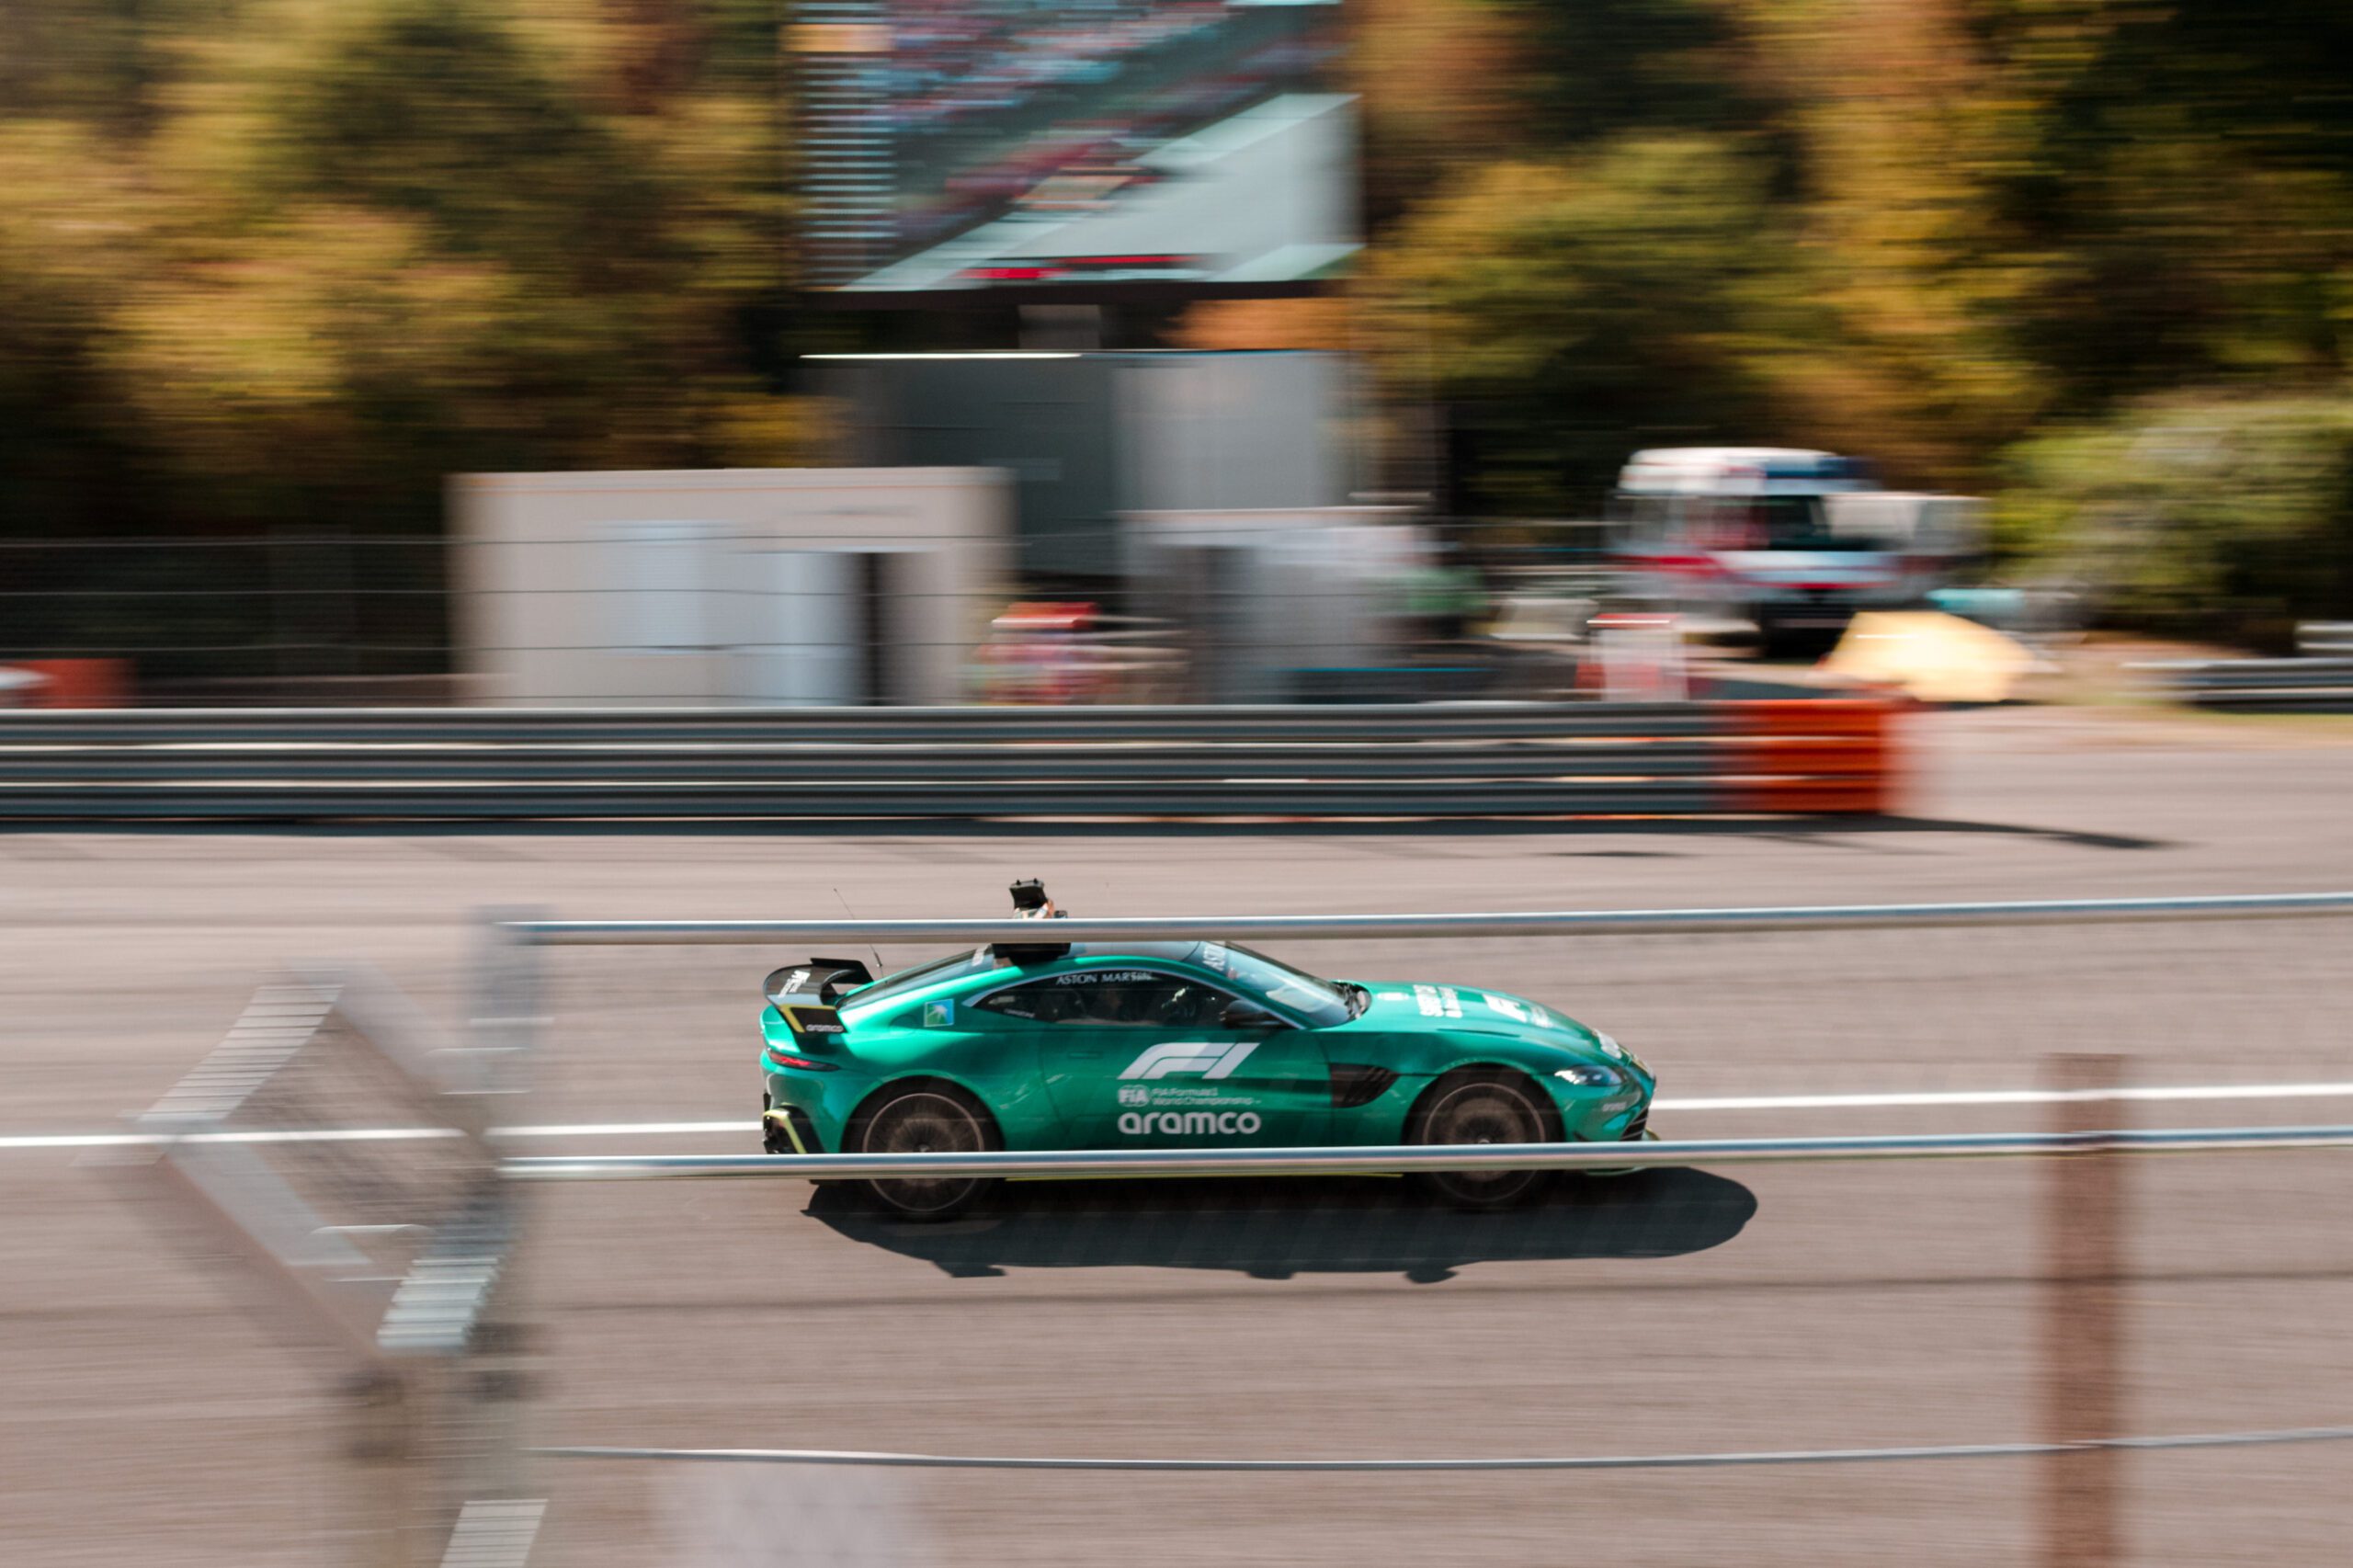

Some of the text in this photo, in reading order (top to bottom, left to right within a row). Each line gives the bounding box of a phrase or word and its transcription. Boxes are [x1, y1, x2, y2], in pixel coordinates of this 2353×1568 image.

[1056, 974, 1097, 985] ASTON
[1117, 1041, 1261, 1080] F1
[1118, 1088, 1149, 1104] FIA
[1118, 1112, 1262, 1134] aramco
